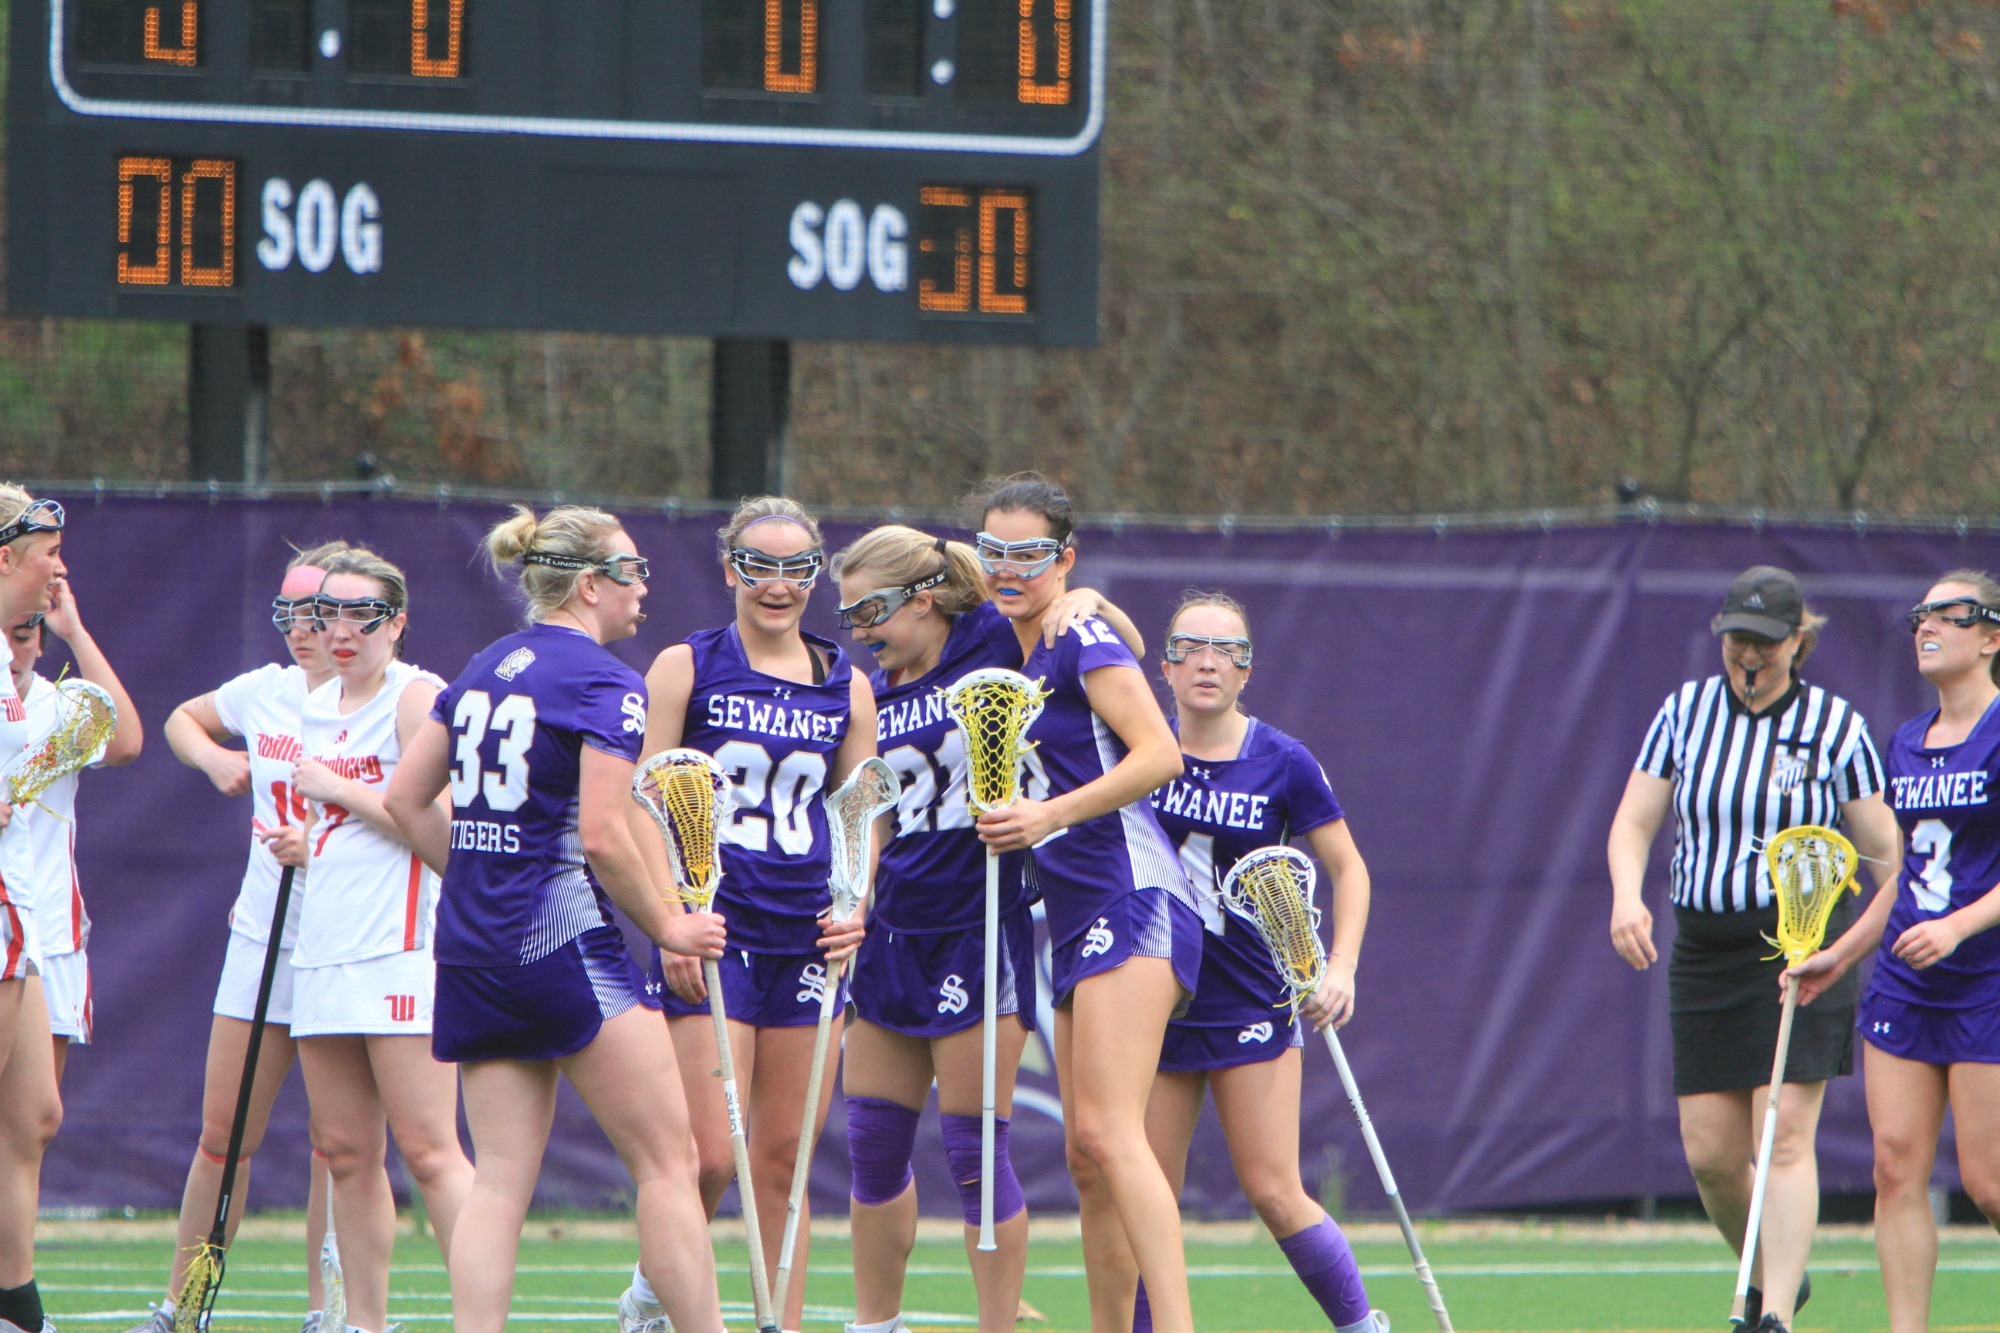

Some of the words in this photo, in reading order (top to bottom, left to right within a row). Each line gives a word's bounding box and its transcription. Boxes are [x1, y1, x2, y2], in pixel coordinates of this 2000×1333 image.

[257, 178, 382, 274] SOG
[787, 198, 909, 292] SOG
[1070, 616, 1120, 647] 12
[450, 690, 537, 812] 33
[876, 684, 955, 742] EWAN
[713, 740, 827, 856] 20
[884, 728, 976, 837] 21
[1150, 780, 1270, 831] EWANEE
[313, 802, 350, 858] 7
[451, 820, 521, 854] TIGERS
[1909, 817, 1953, 913] 3
